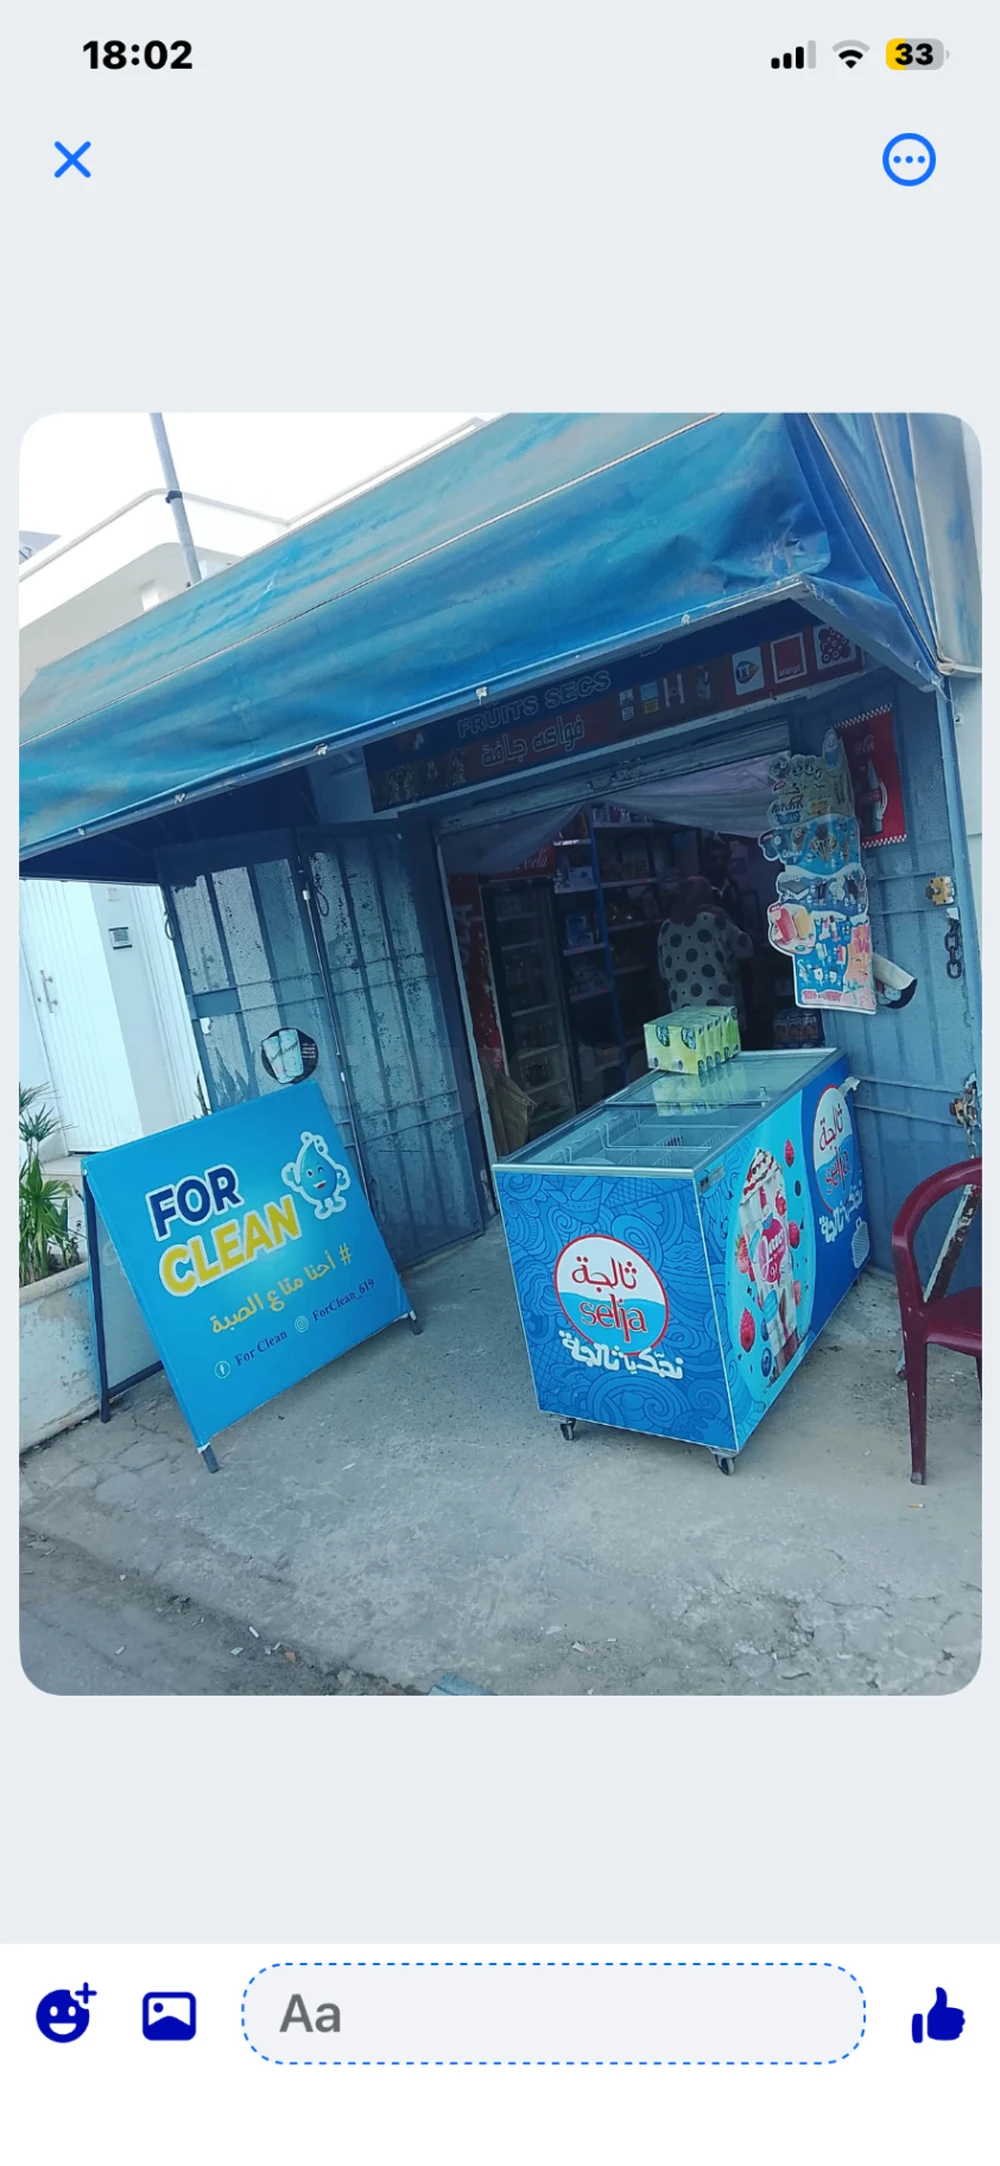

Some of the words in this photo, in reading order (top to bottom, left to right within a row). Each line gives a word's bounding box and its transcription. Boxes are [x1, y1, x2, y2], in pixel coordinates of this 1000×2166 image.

[457, 695, 539, 738] FRUITS
[544, 670, 611, 708] SECS
[481, 733, 527, 767] جافة
[819, 1103, 844, 1151] ثالجة
[825, 1146, 850, 1194] selja
[147, 1166, 243, 1240] FOR
[161, 1196, 300, 1295] CLEAN
[304, 1250, 337, 1281] أحنا
[571, 1256, 637, 1293] ثالجة
[209, 1292, 264, 1334] الصبة
[312, 1278, 375, 1321] ForClean_619
[580, 1293, 648, 1343] selja
[234, 1348, 255, 1366] For
[256, 1329, 288, 1352] Clean
[558, 1330, 624, 1371] ثالجة
